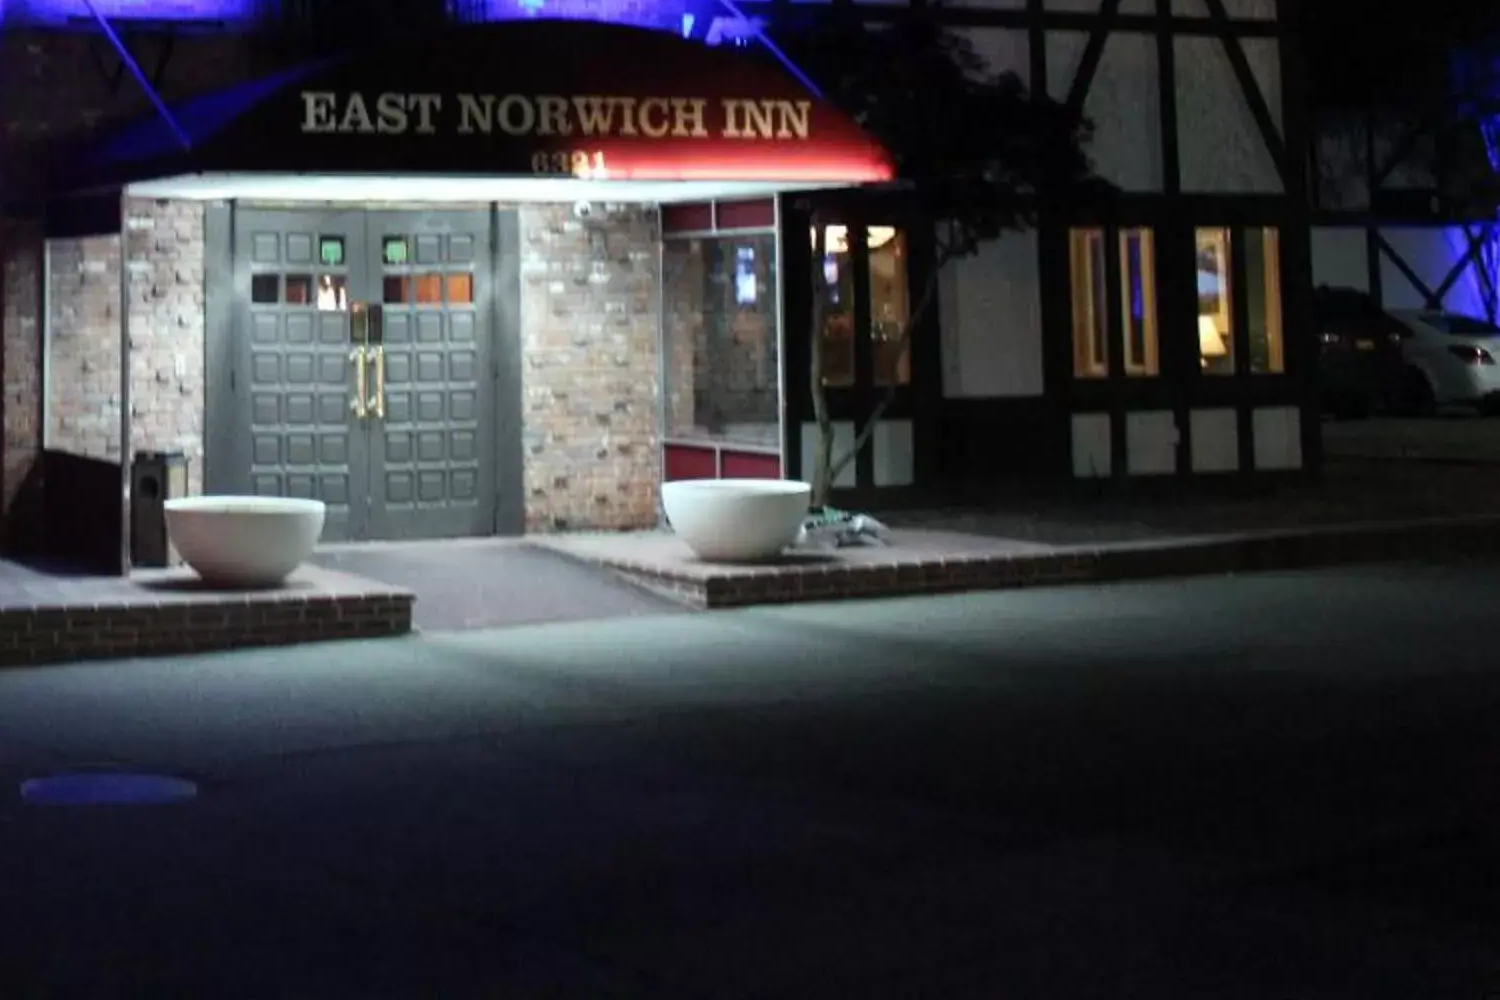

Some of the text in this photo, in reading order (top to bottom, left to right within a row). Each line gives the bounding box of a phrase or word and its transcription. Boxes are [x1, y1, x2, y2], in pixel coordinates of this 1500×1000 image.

[301, 91, 812, 139] EAST NORWICH INN
